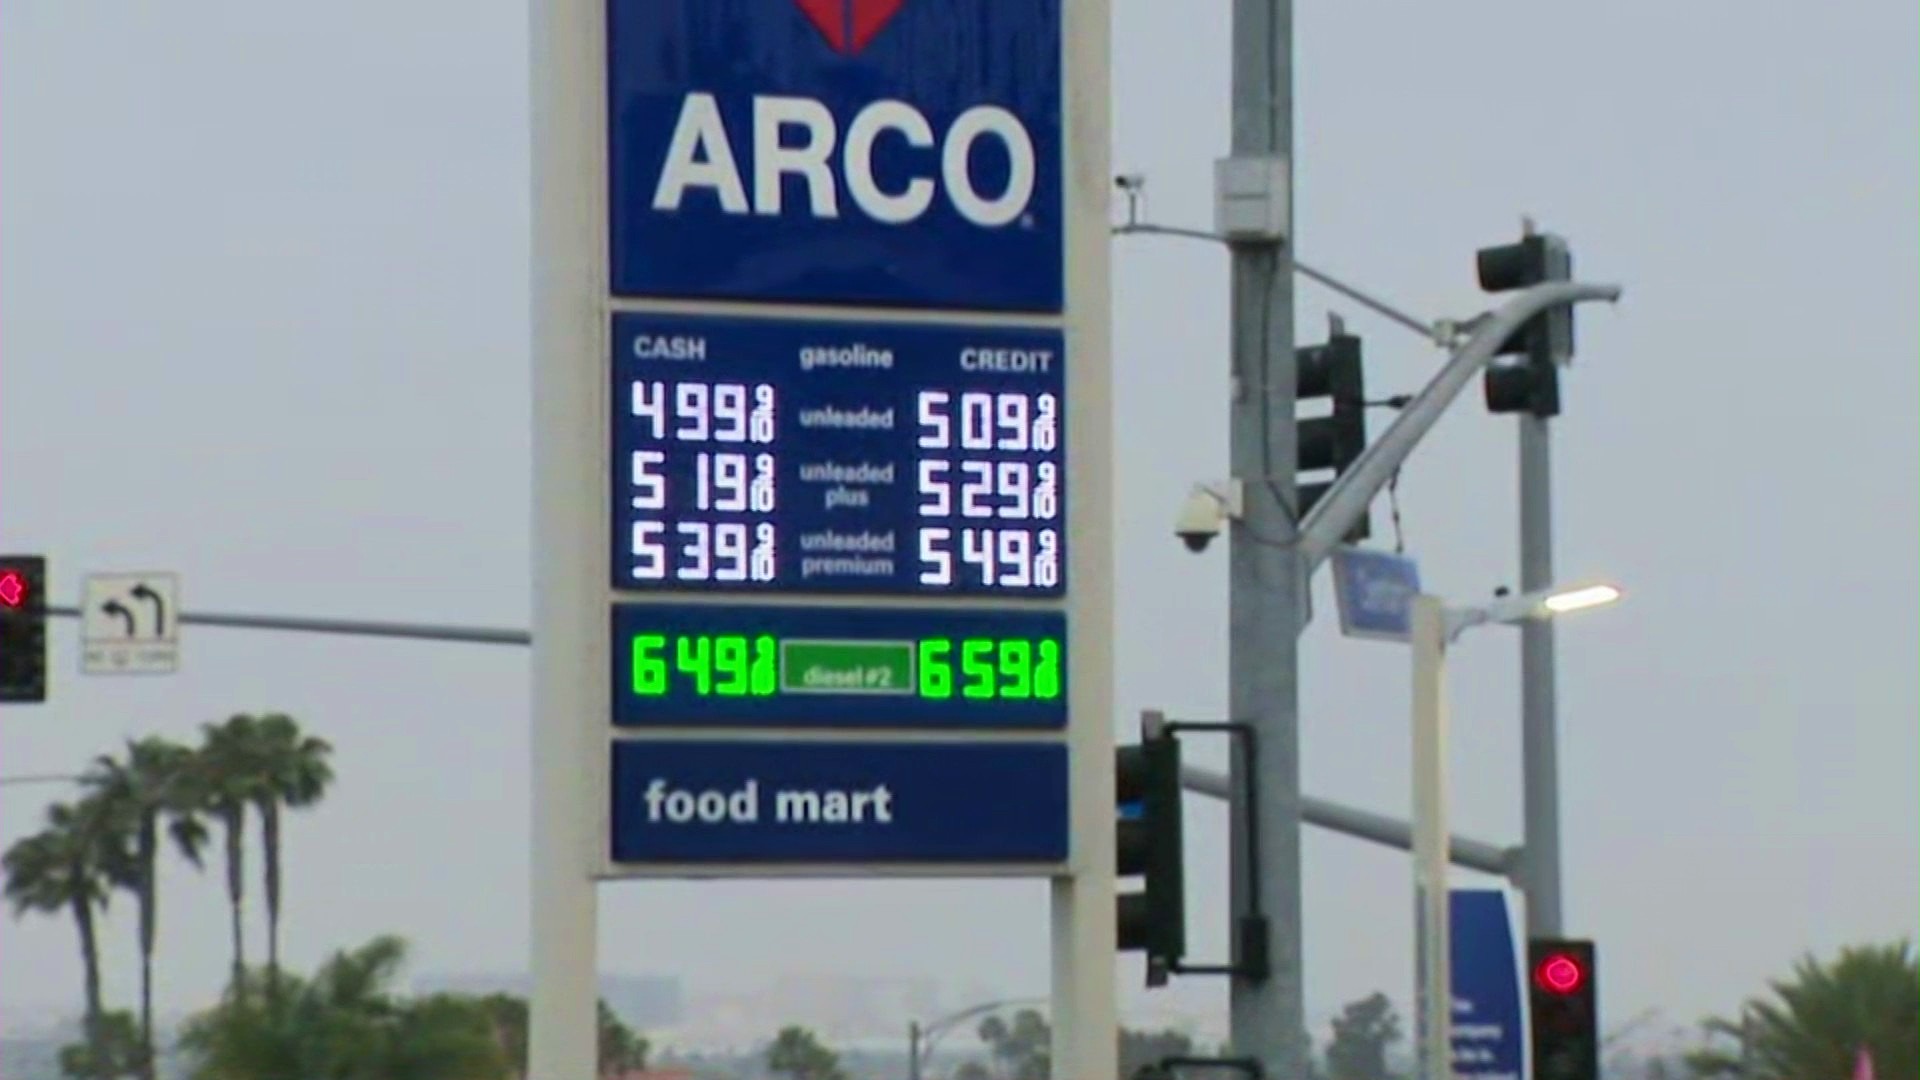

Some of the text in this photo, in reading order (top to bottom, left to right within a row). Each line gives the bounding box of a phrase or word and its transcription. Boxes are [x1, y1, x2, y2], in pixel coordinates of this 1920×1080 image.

[652, 92, 1035, 226] ARCO
[634, 336, 705, 359] CASH
[800, 344, 893, 369] gasoline
[961, 348, 1052, 371] CREDIT
[800, 406, 893, 428] unleaded
[800, 462, 894, 483] unleaded
[826, 486, 869, 508] plus
[801, 531, 894, 551] unleaded
[802, 556, 893, 577] premium
[645, 780, 891, 821] food mart
